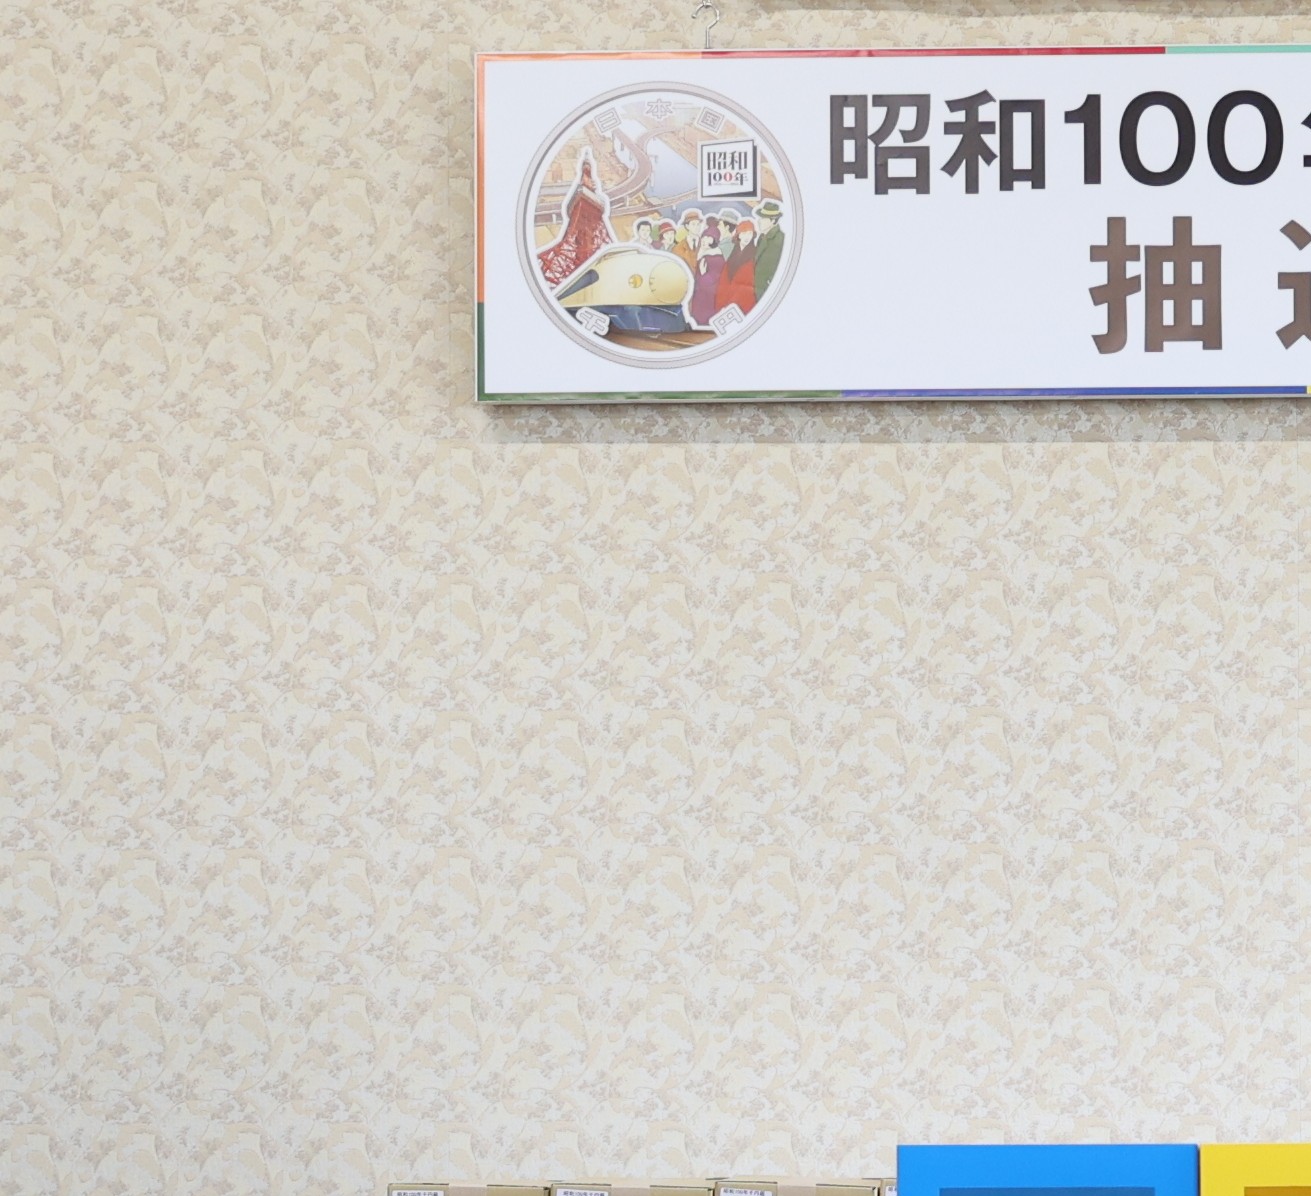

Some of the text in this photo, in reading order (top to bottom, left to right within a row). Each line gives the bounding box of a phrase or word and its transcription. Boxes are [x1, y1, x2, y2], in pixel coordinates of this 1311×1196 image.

[595, 99, 724, 132] 日本国
[707, 150, 748, 170] 昭和
[708, 171, 749, 187] 100年
